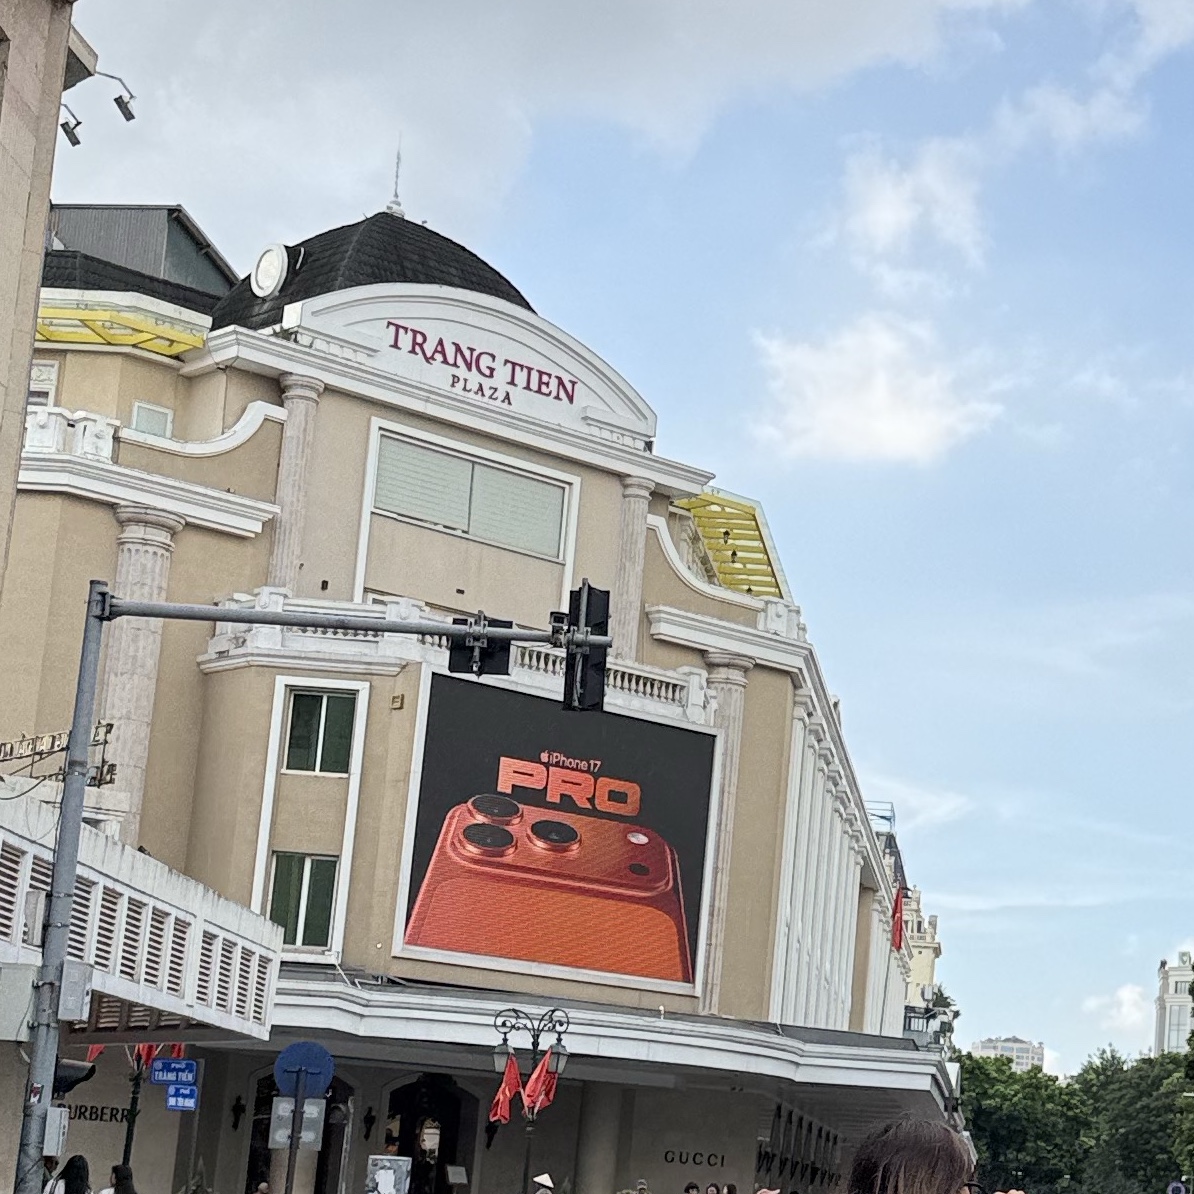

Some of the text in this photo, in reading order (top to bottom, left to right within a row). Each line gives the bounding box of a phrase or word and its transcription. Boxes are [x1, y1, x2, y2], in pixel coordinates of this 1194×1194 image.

[386, 320, 578, 405] TRANG TIEN
[450, 374, 513, 406] PLAZA
[549, 752, 601, 773] iPhone 17
[497, 756, 641, 816] PRO
[58, 1103, 138, 1123] URBERR
[664, 1150, 725, 1167] GUCCI
